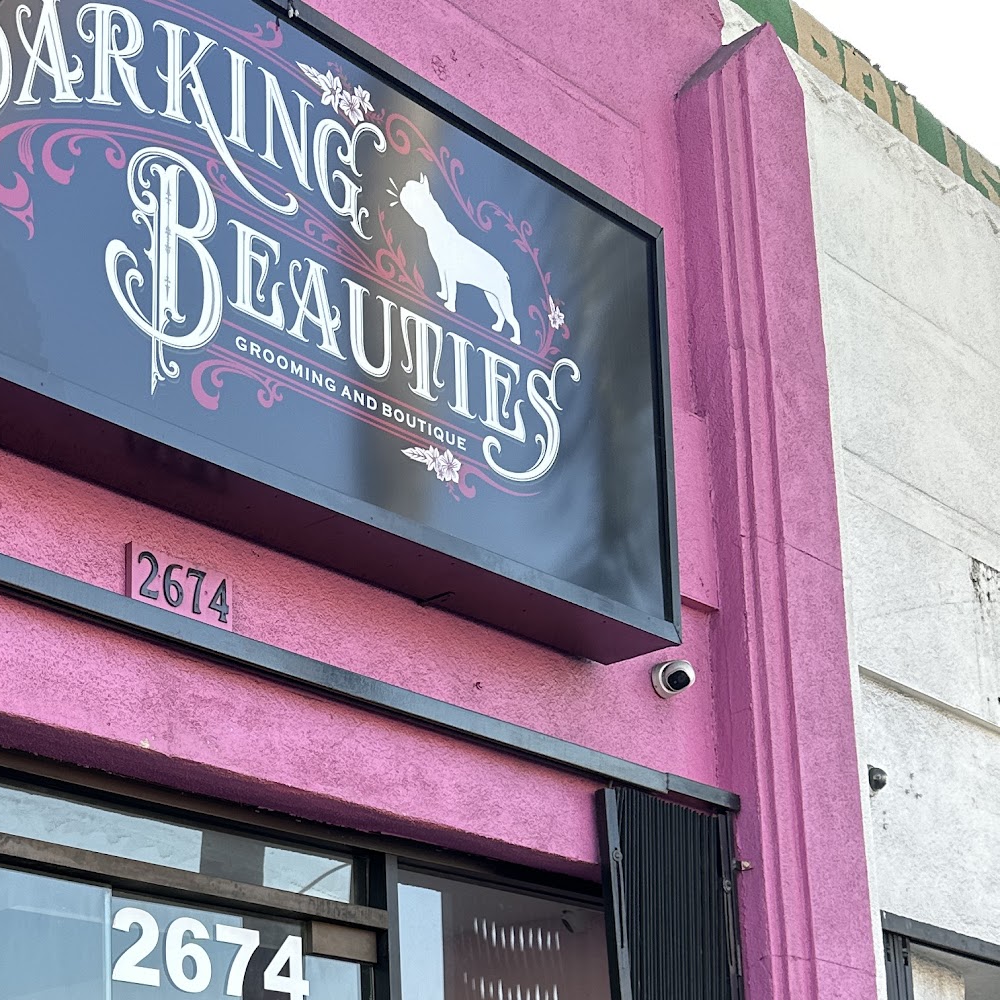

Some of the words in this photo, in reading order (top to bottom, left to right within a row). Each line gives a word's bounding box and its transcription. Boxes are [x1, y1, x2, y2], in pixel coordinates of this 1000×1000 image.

[105, 146, 582, 482] BEAUTIES
[235, 336, 337, 392] GROOMING
[341, 387, 378, 411] AND
[382, 402, 467, 451] BOUTIQUE
[137, 550, 230, 624] 2674
